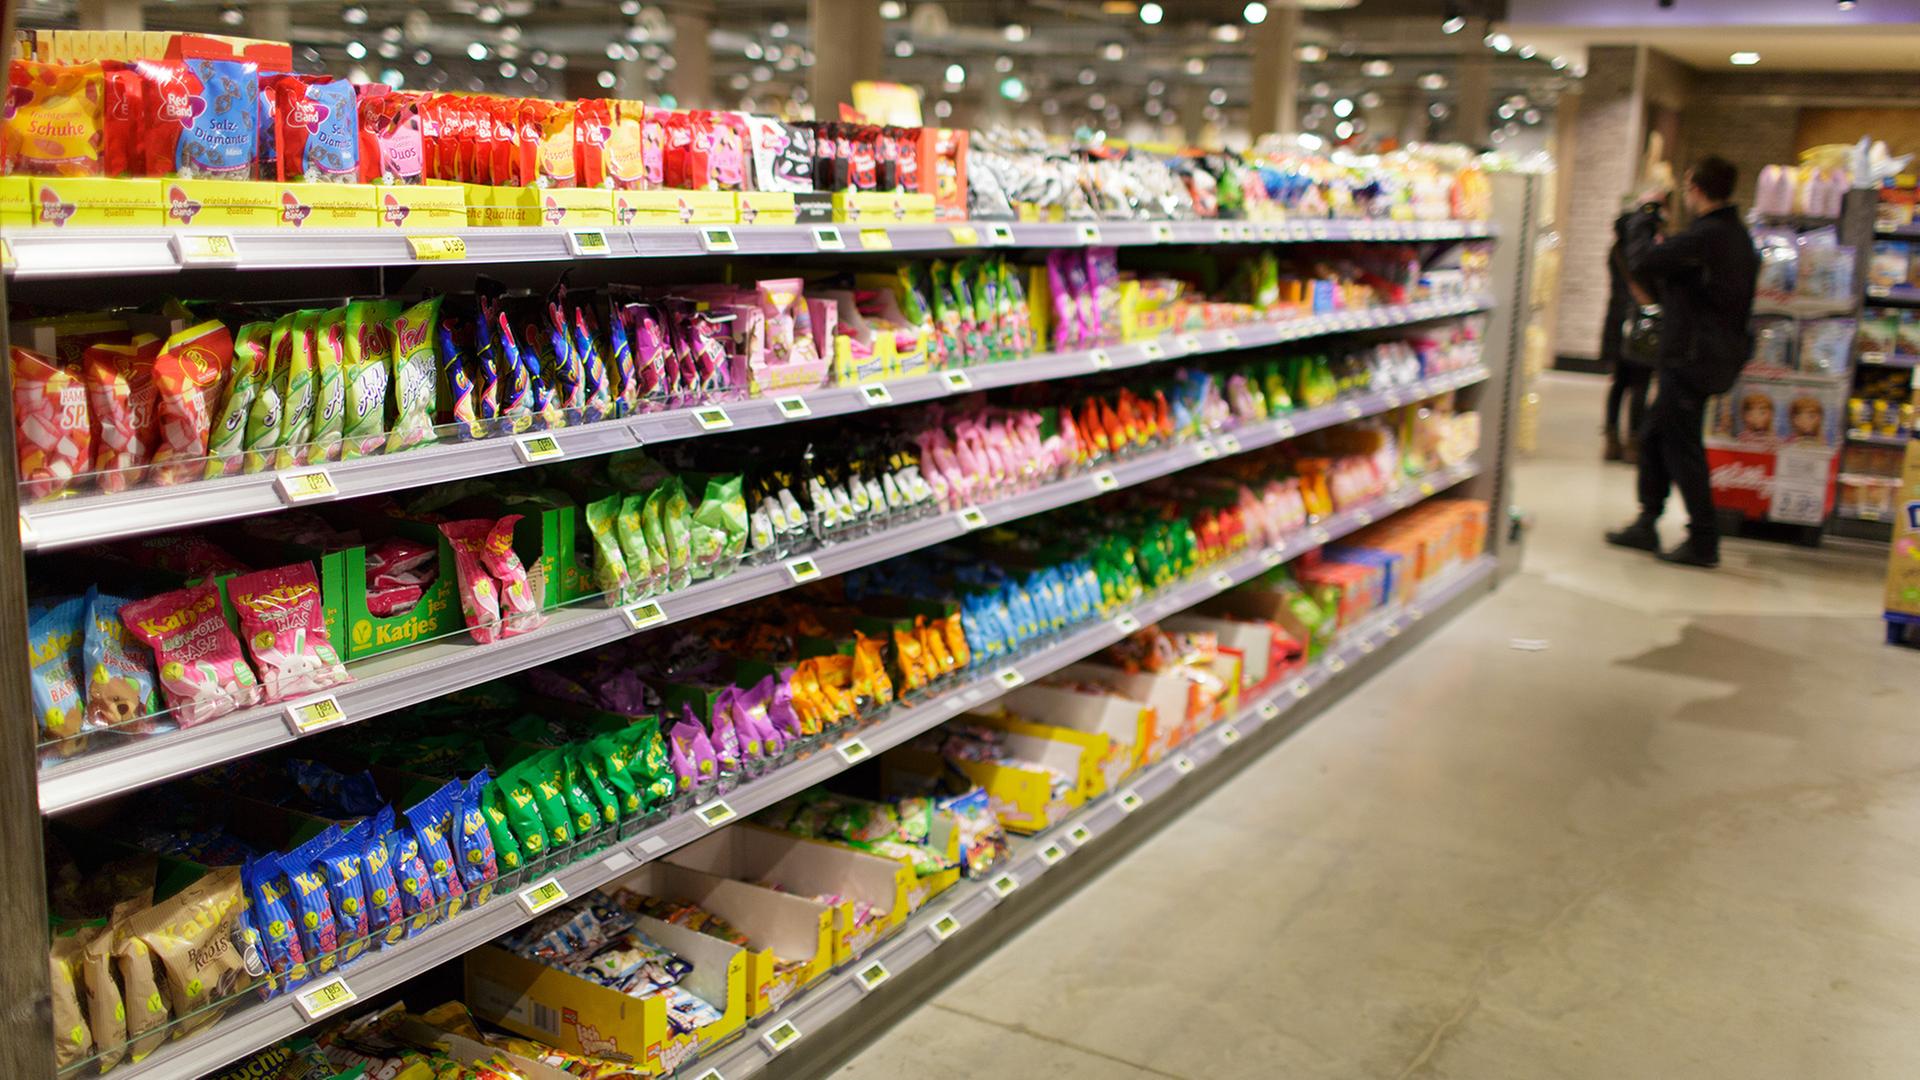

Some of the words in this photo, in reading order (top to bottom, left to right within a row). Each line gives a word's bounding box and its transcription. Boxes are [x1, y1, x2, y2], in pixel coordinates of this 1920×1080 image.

[167, 93, 188, 106] Red
[166, 105, 193, 117] Band
[294, 110, 319, 123] Band
[28, 120, 84, 137] Schuhe
[485, 207, 526, 222] Qualität
[376, 617, 438, 646] Katjes
